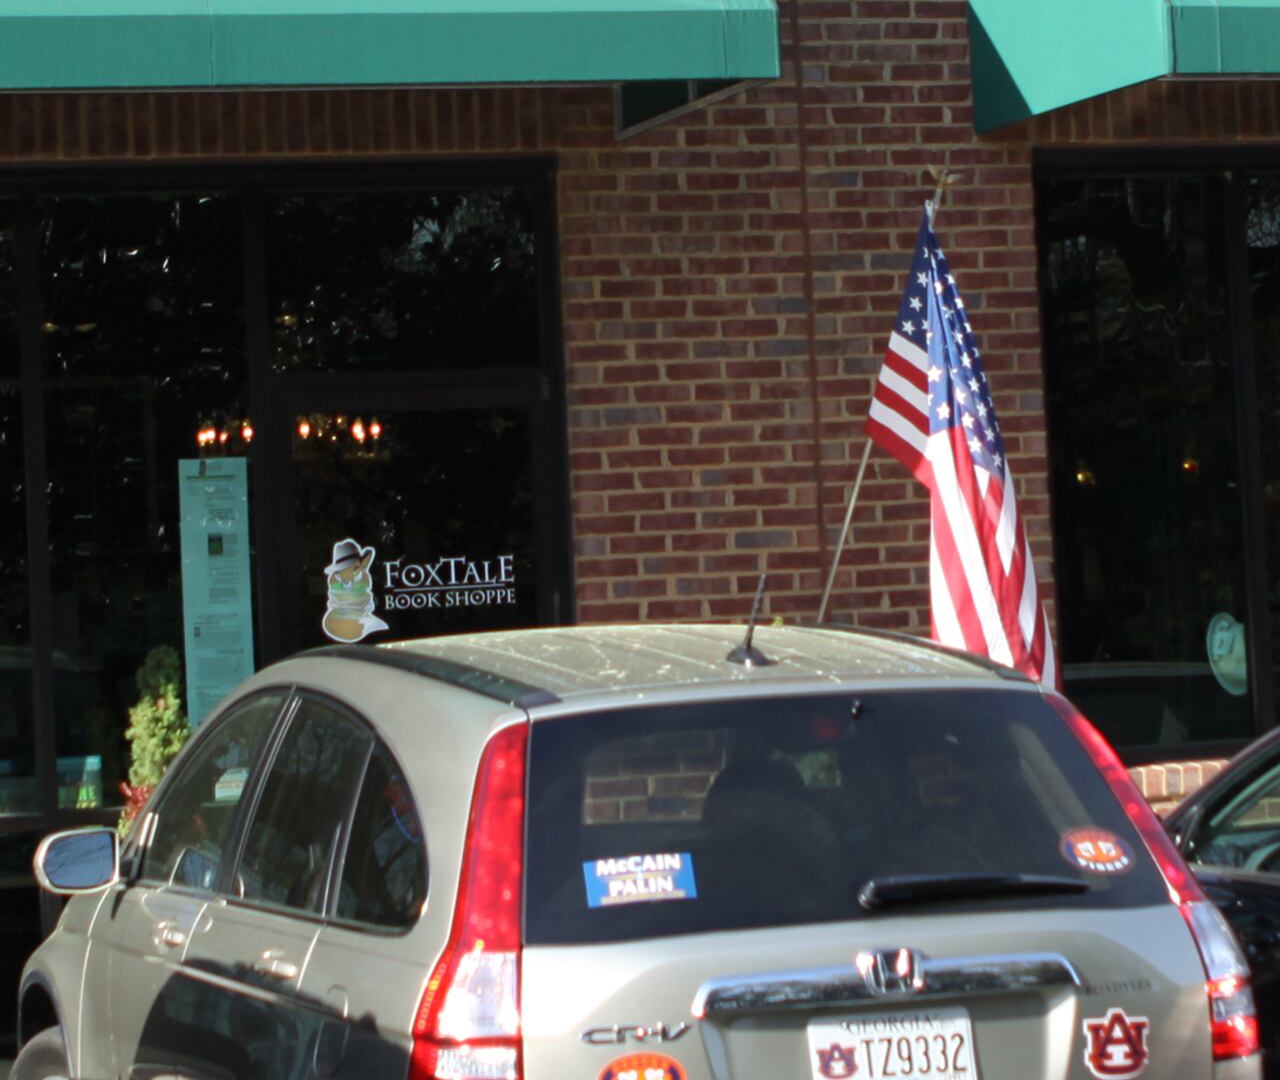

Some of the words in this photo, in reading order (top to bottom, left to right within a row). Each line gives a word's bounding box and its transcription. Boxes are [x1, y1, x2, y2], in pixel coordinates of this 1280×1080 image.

[384, 590, 441, 611] BOOK
[444, 587, 517, 608] SHOPPE
[608, 875, 675, 898] PALIN
[579, 1021, 693, 1045] CR-V
[859, 1031, 969, 1079] TZ9332
